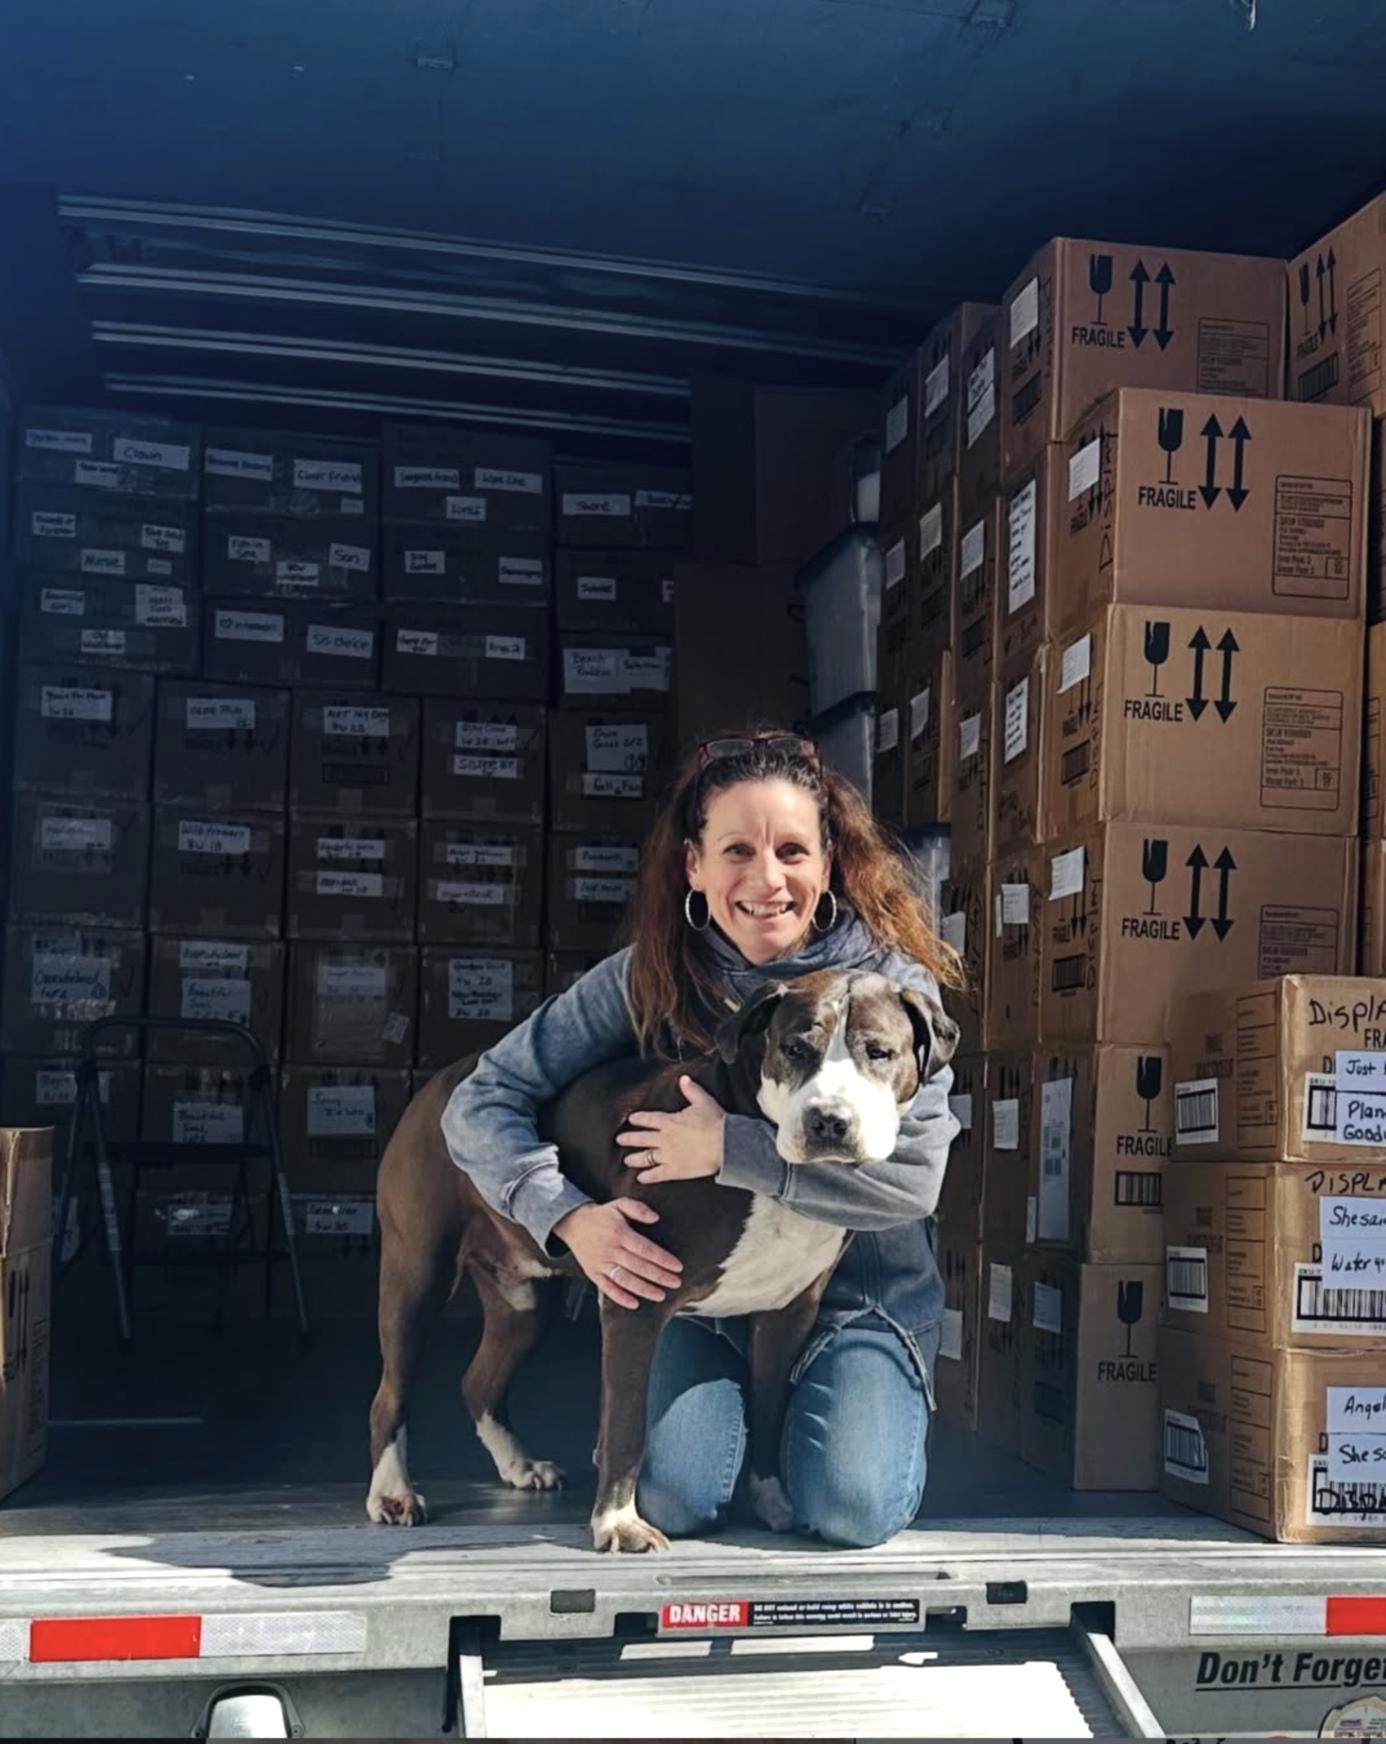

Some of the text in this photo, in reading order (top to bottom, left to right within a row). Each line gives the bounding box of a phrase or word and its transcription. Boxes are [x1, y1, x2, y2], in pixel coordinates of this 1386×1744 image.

[1071, 326, 1126, 349] FRAGILE
[1138, 486, 1197, 510] FRAGILE
[1124, 699, 1183, 722] FRAGILE
[1121, 917, 1180, 940] FRAGILE
[1346, 1058, 1376, 1076] Just
[1098, 1362, 1157, 1382] FRAGILE
[669, 1603, 741, 1623] DANGER
[1196, 1652, 1283, 1684] Don't
